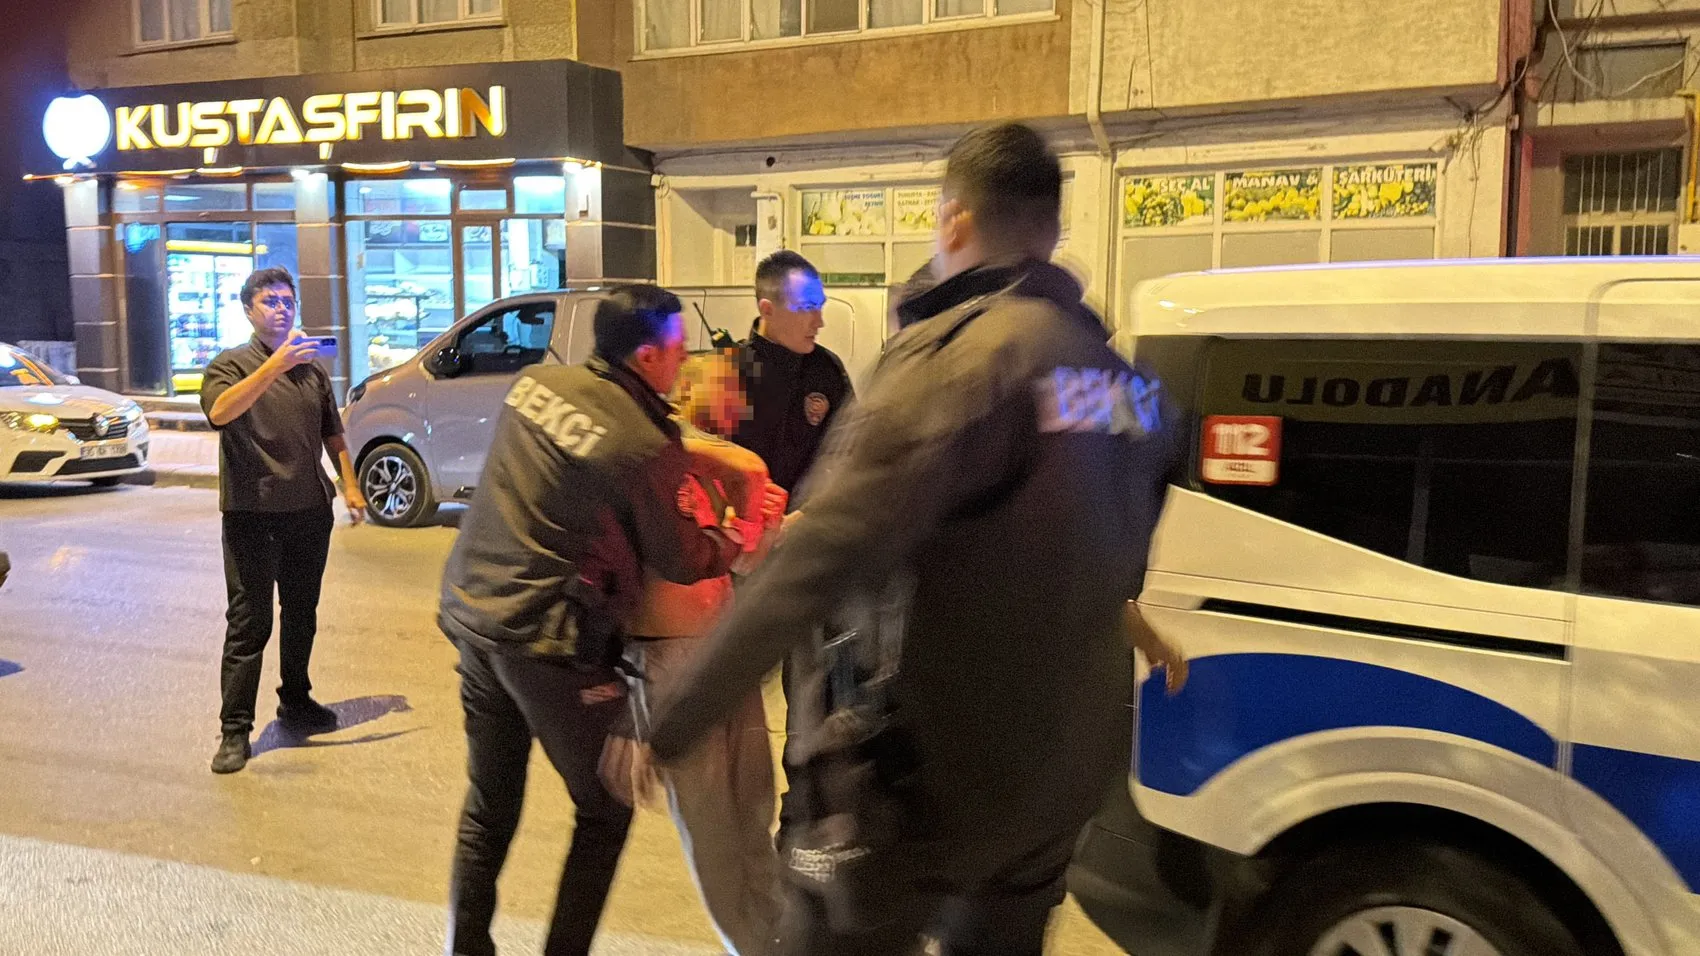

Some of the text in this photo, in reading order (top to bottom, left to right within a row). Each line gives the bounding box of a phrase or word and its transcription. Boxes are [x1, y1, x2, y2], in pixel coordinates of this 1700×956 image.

[1232, 174, 1300, 189] MANAV
[1306, 170, 1318, 185] &
[1210, 423, 1270, 456] 112
